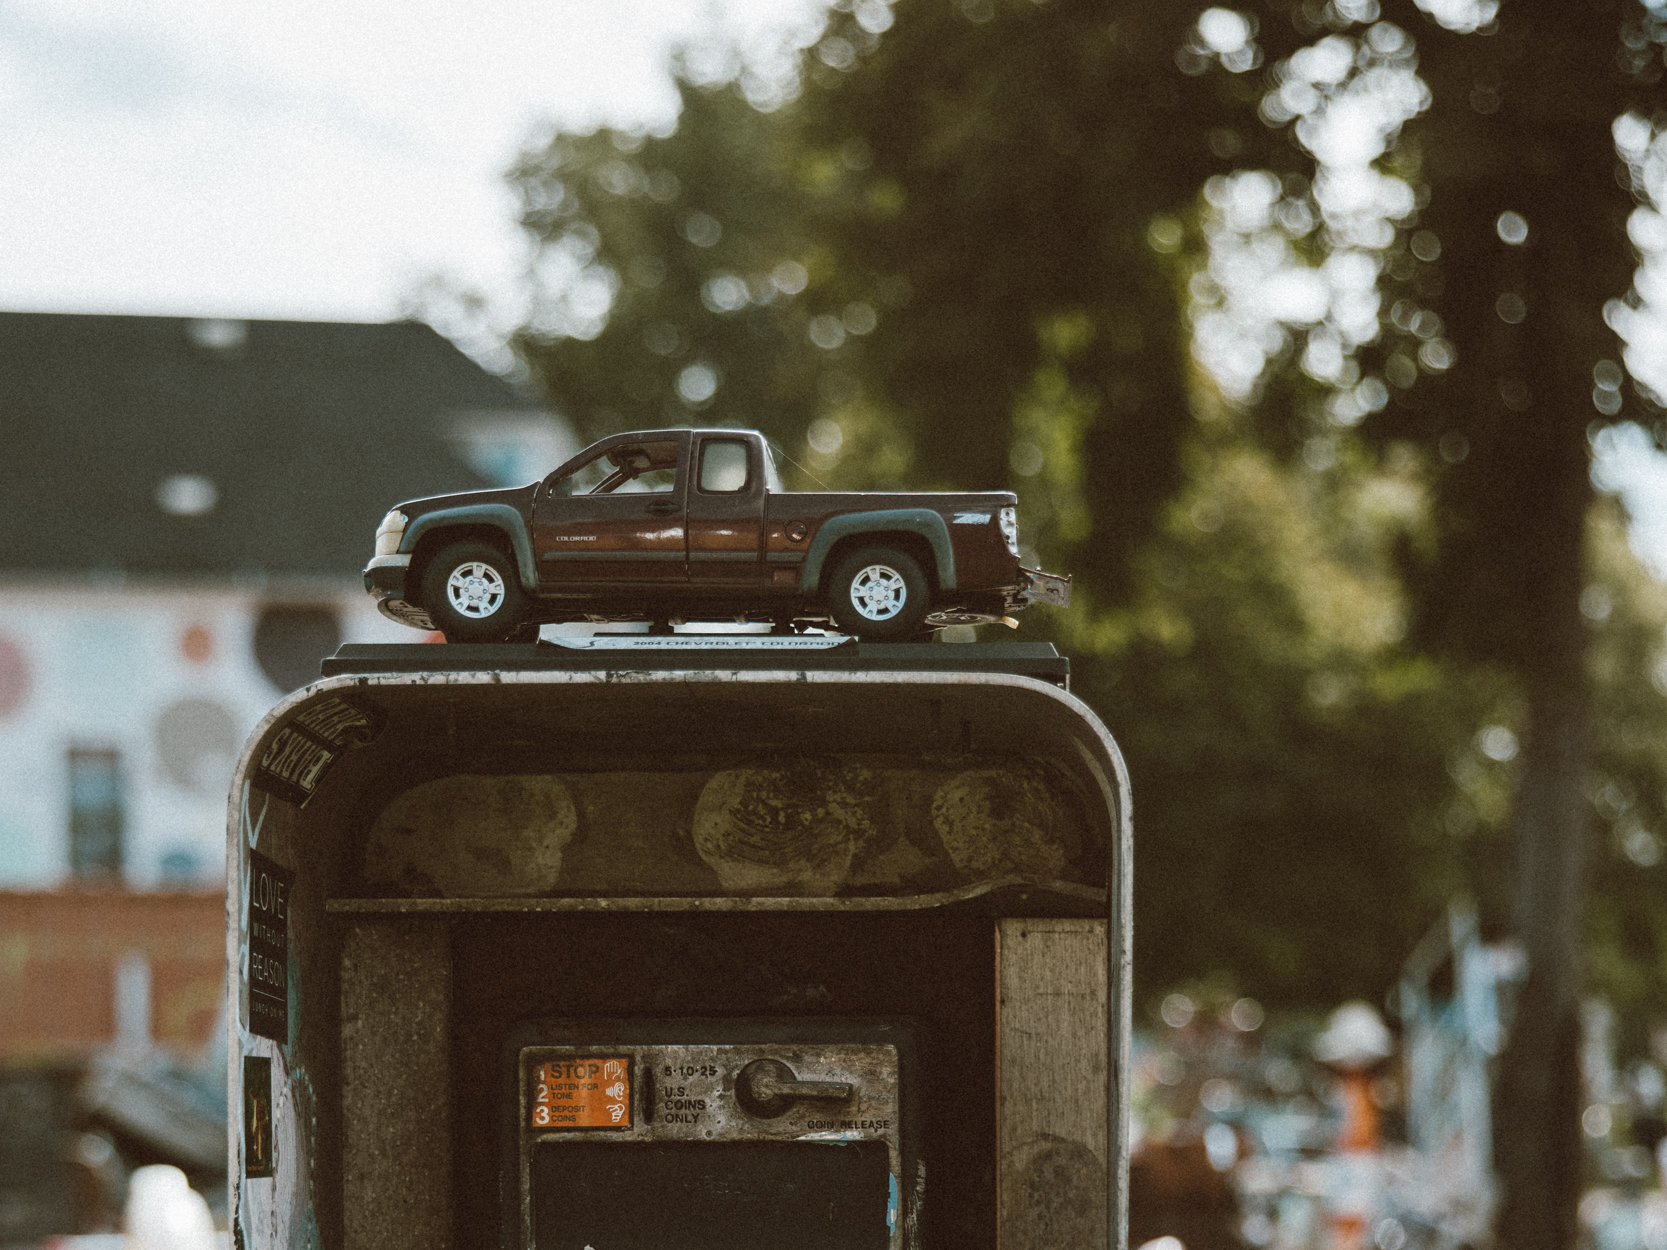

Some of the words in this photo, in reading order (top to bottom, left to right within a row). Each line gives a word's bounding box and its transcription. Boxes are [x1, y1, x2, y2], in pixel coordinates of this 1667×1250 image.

[253, 868, 284, 919] LOVE
[252, 922, 285, 949] WITHOUT
[252, 952, 285, 988] REASON
[550, 1064, 600, 1080] STOP
[537, 1084, 549, 1102] 2
[551, 1083, 580, 1091] LISTEN
[552, 1092, 573, 1100] TONE
[664, 1087, 689, 1098] U.S.
[664, 1100, 706, 1110] COINS
[536, 1106, 549, 1125] 3
[551, 1105, 586, 1113] DEPOSIT
[664, 1112, 700, 1123] ONLY
[807, 1120, 834, 1129] COIN
[840, 1120, 890, 1129] RELEASE
